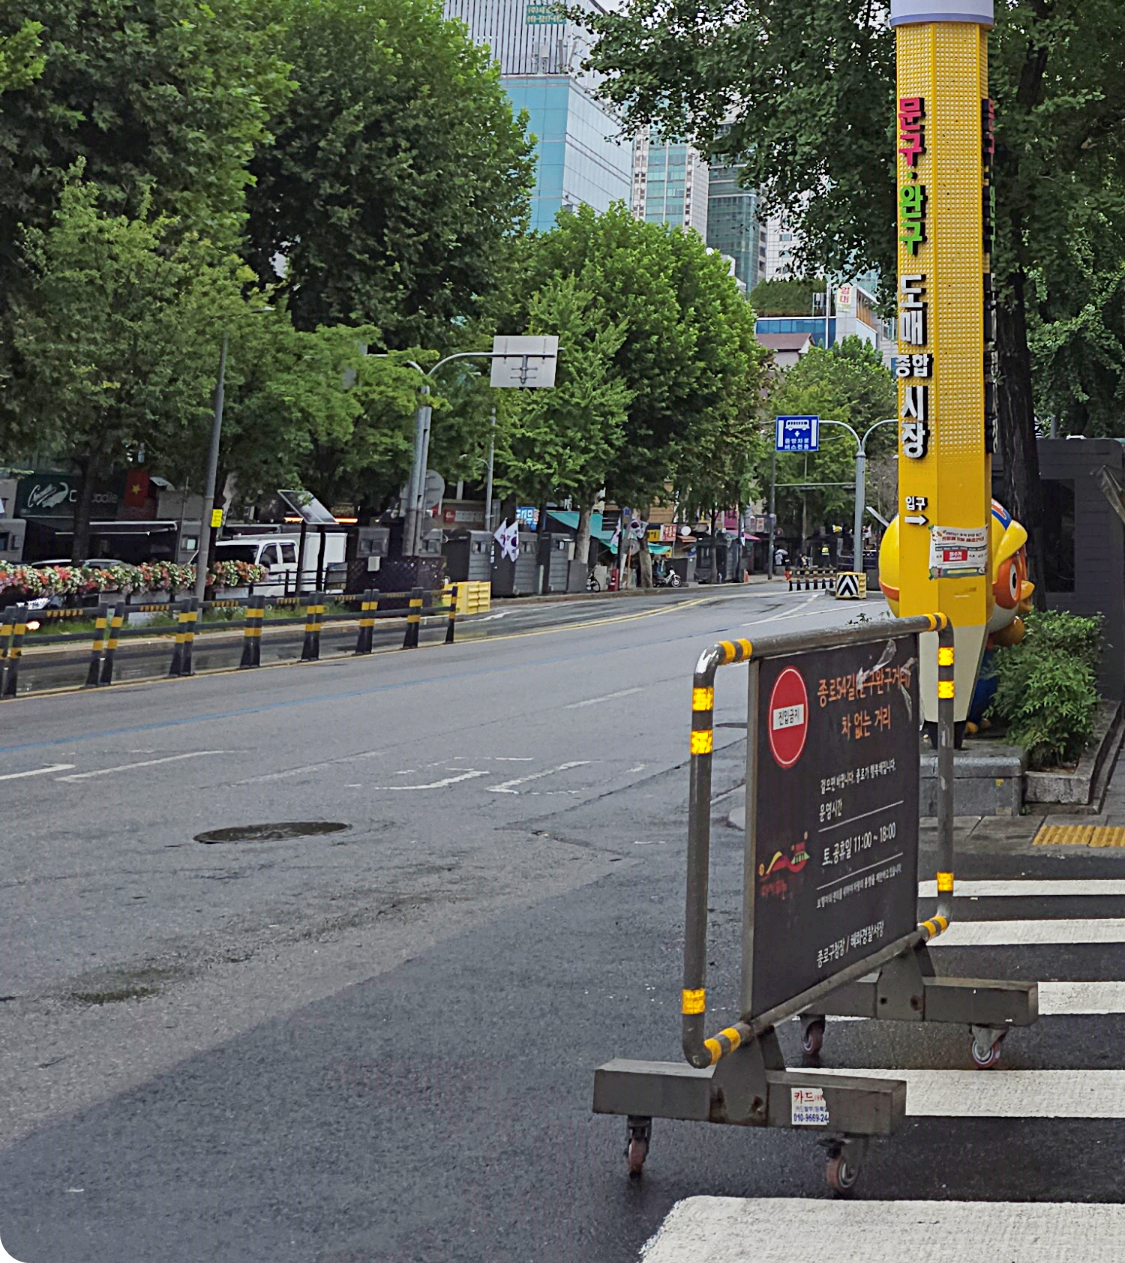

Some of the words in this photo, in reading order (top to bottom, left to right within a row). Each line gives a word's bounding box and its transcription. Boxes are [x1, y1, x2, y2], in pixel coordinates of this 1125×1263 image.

[900, 274, 923, 346] 도매
[895, 354, 930, 378] 종합
[900, 385, 926, 459] 시장
[905, 496, 926, 511] 입구
[778, 707, 800, 726] 진입금지
[841, 713, 852, 740] 차
[853, 709, 873, 739] 없는
[874, 704, 891, 732] 거리
[819, 798, 843, 823] 운영시간
[854, 831, 872, 853] 11:00
[794, 1090, 815, 1104] 카드
